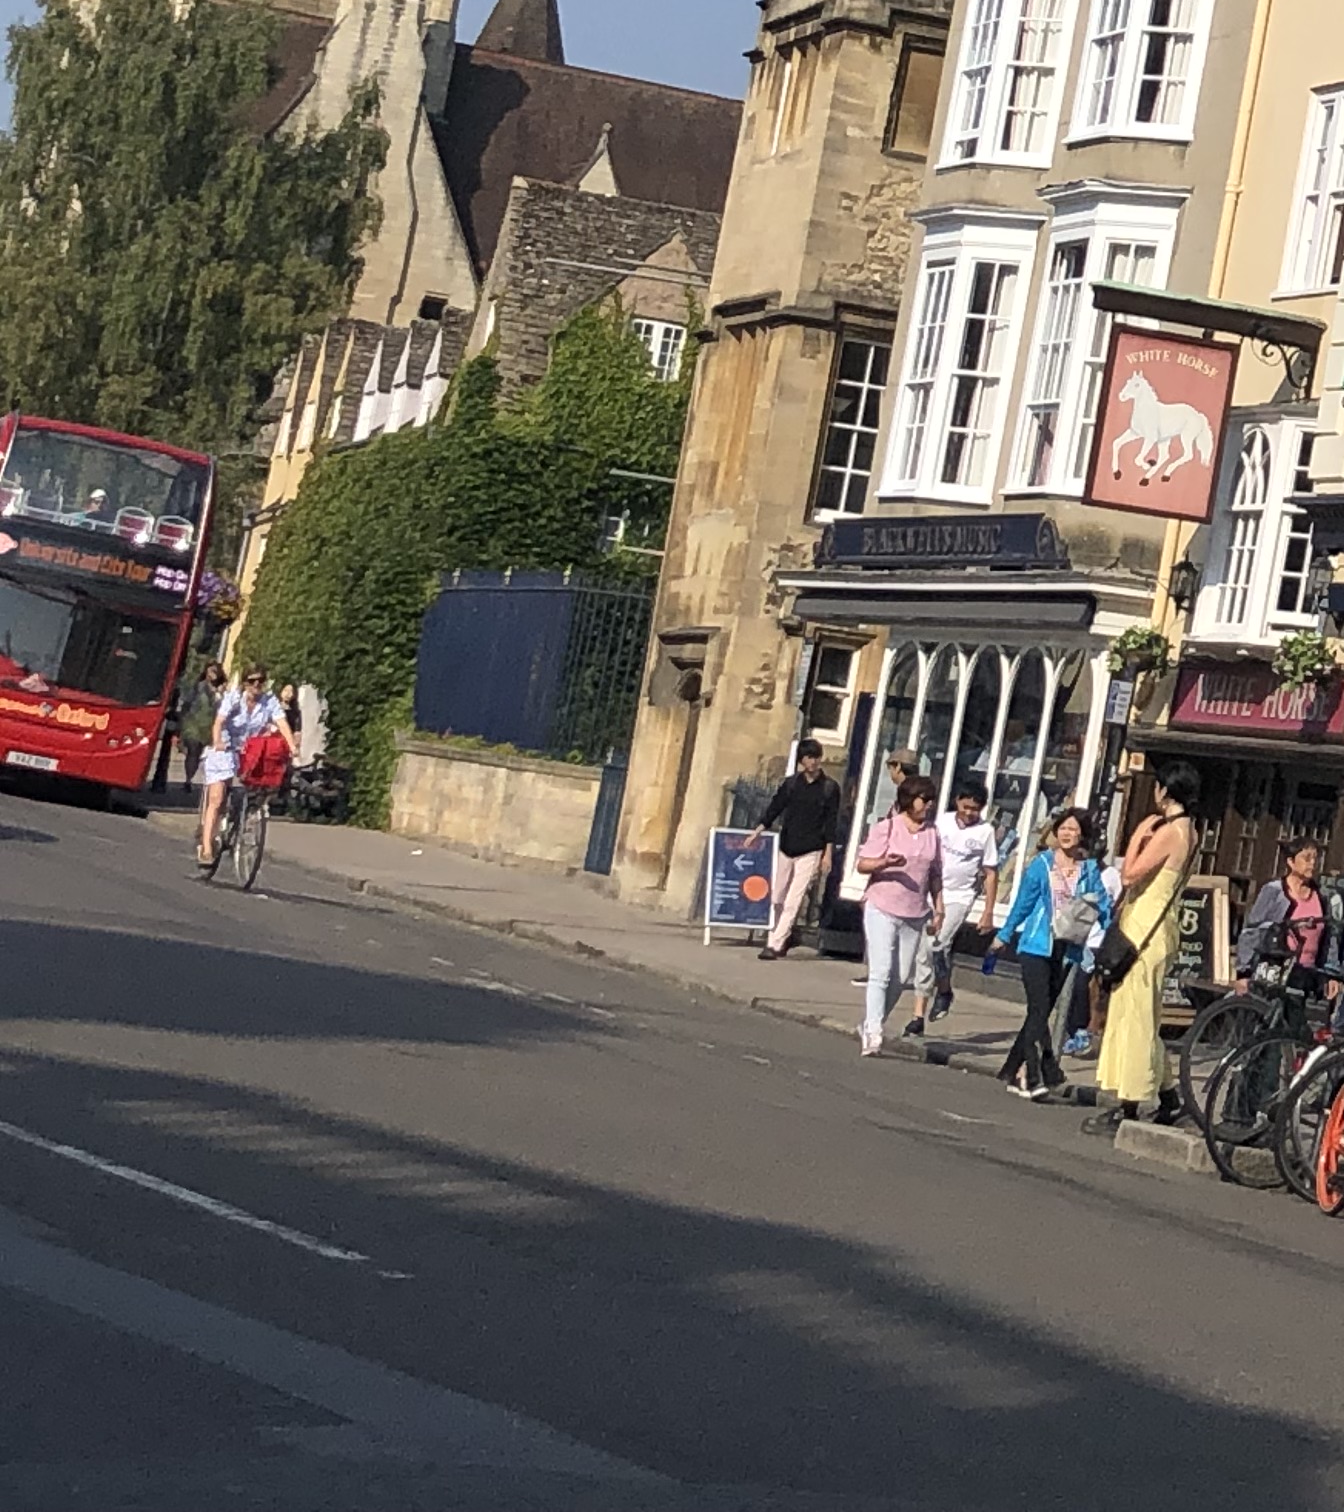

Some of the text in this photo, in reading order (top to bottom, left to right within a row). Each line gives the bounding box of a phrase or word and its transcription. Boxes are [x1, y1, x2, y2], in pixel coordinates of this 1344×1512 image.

[1125, 349, 1219, 378] WHITE HORSE
[952, 524, 1002, 553] MUSIC
[1194, 672, 1330, 722] WHITE HORSE
